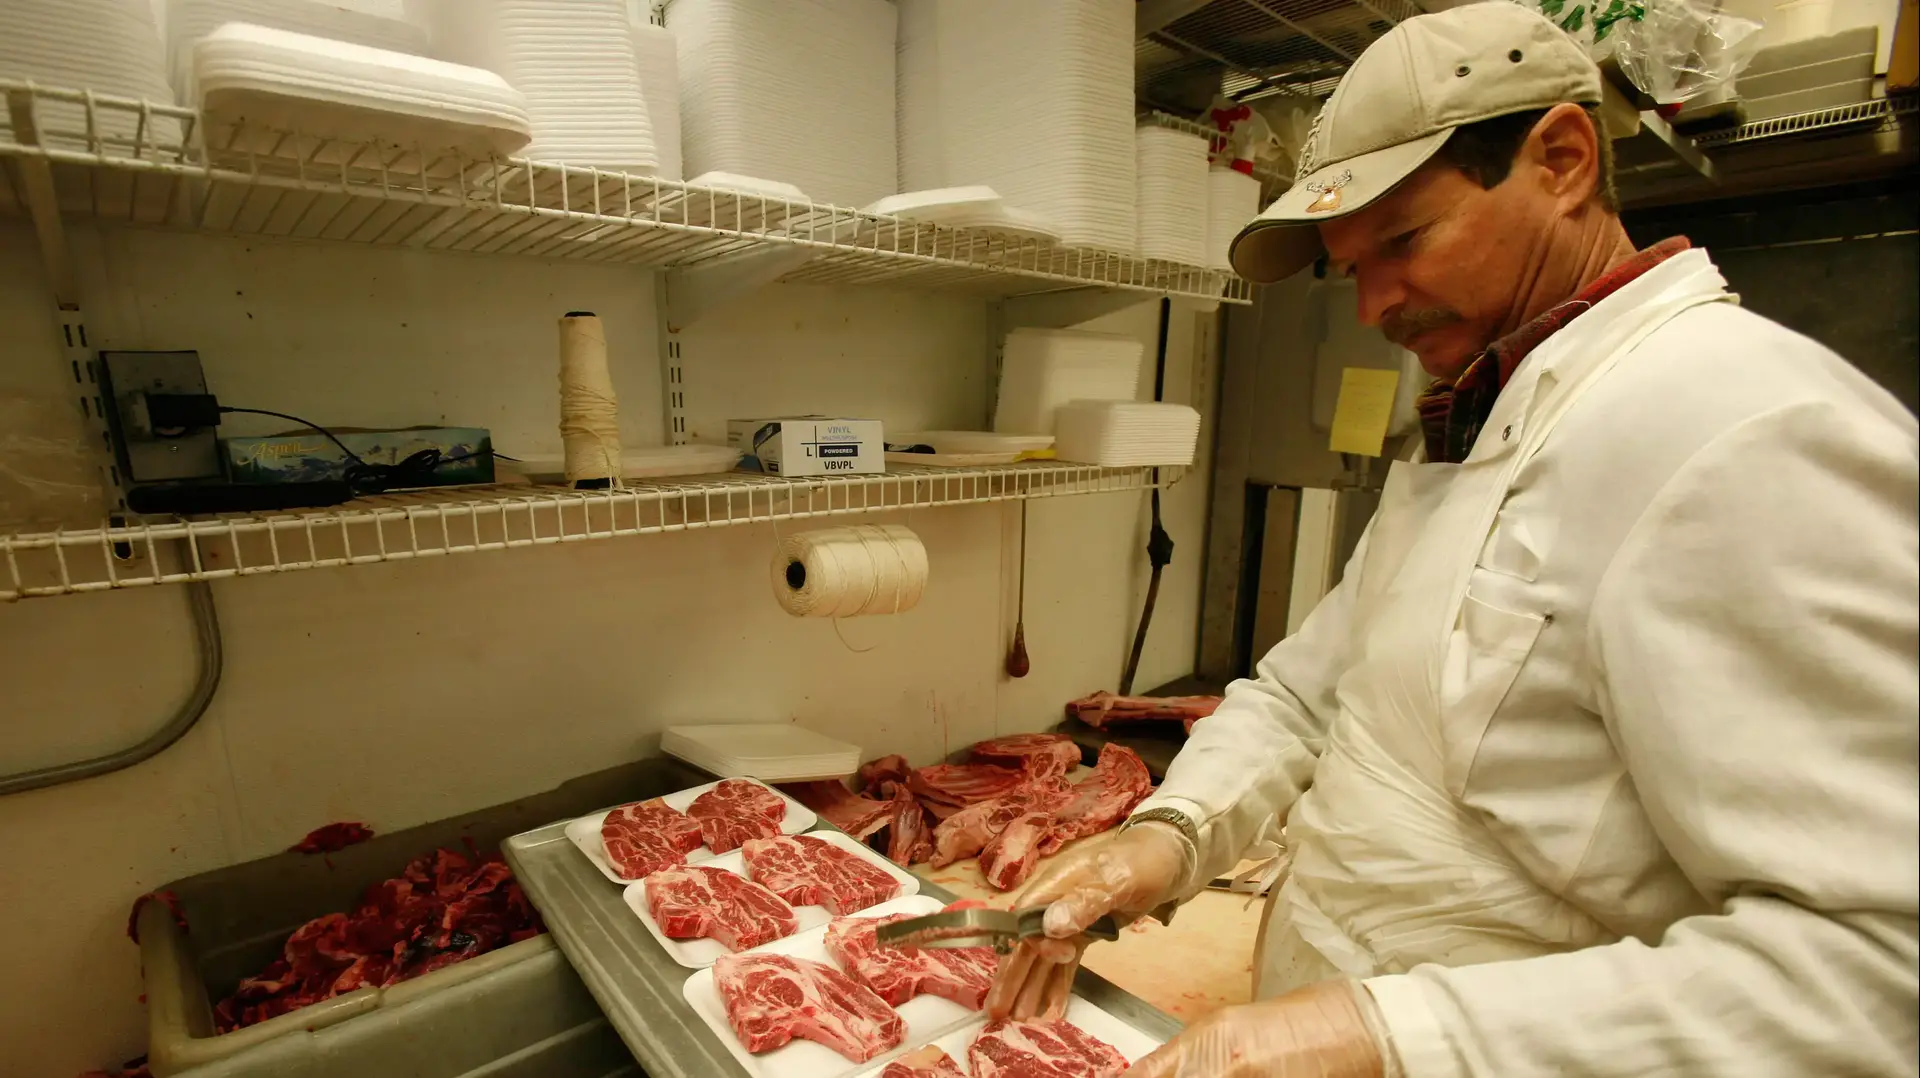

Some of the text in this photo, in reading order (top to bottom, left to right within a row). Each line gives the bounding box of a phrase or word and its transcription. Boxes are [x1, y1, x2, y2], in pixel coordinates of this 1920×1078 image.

[827, 426, 852, 434] VINYL
[806, 446, 813, 457] L
[823, 460, 854, 470] VBVPL
